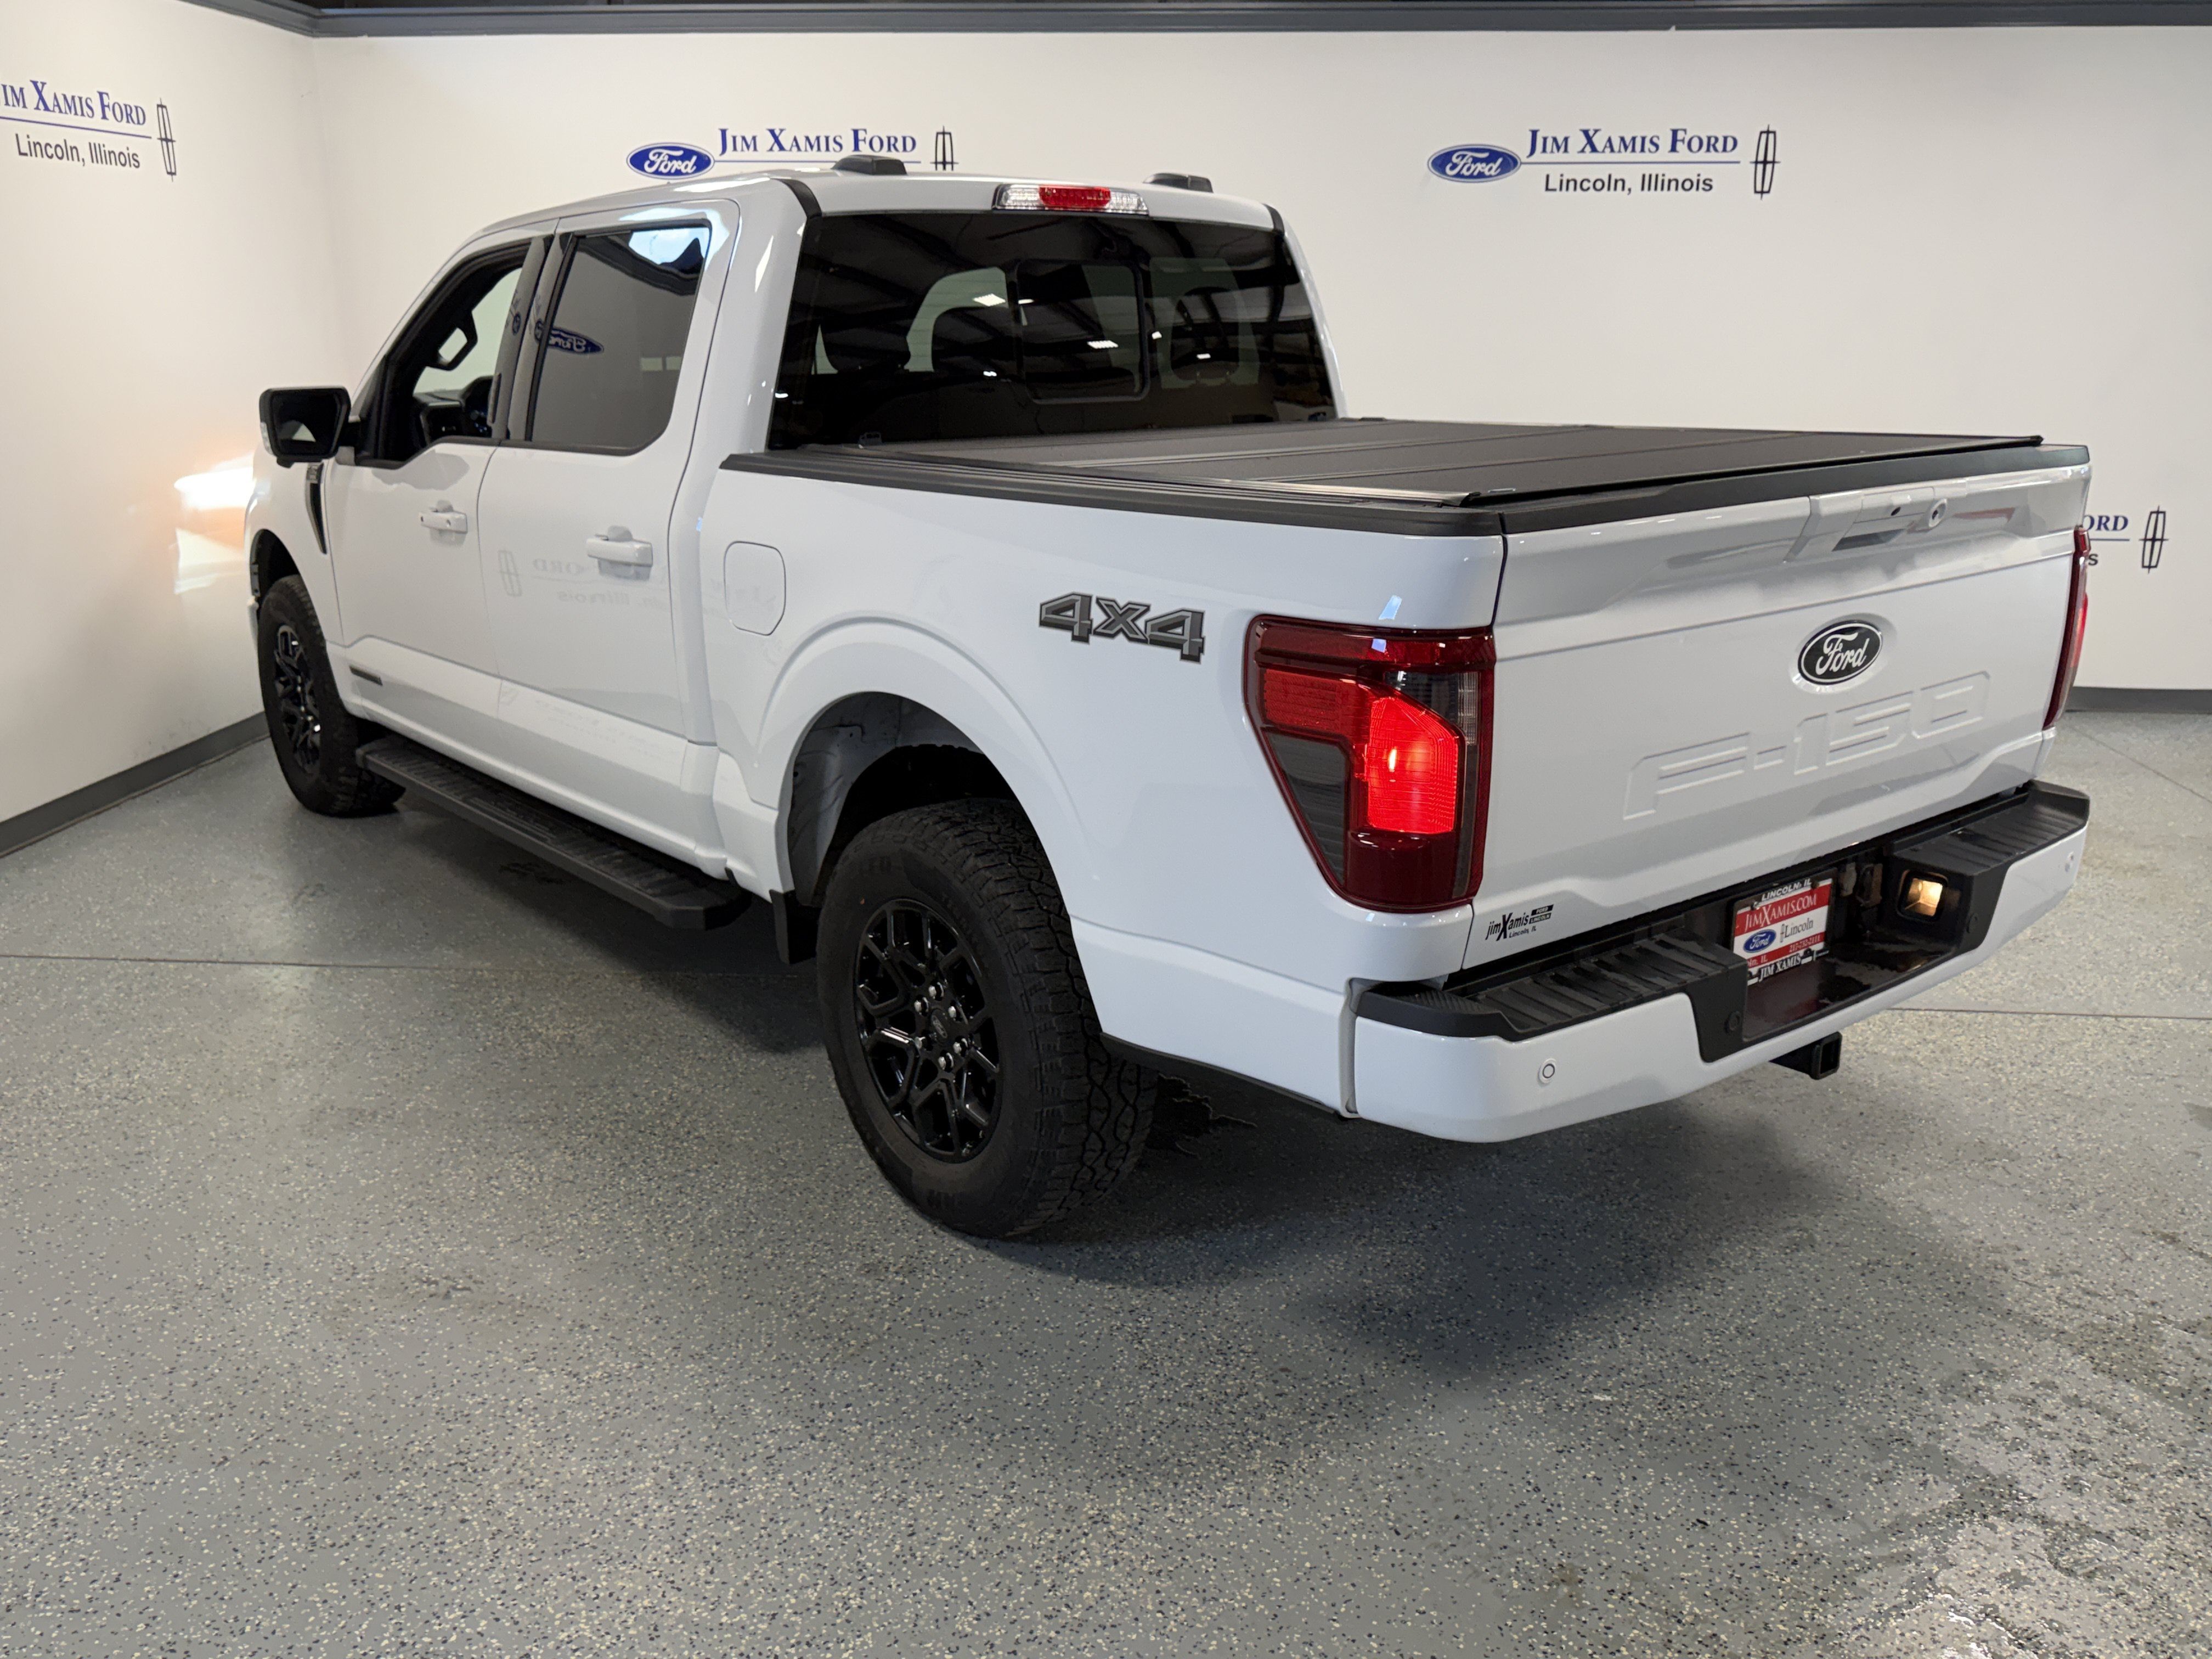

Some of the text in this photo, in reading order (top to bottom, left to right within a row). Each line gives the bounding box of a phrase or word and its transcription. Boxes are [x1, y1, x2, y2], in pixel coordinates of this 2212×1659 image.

[0, 80, 146, 126] IM XAMIS FORD
[15, 133, 140, 168] Lincoln, Illinois
[718, 128, 917, 156] JIM XAMIS FORD
[1526, 128, 1738, 158] JIM XAMIS FORD
[644, 149, 697, 173] Ford
[1445, 151, 1503, 176] Ford
[1544, 173, 1713, 195] Lincoln, Illinois
[2084, 515, 2129, 531] ORD
[1815, 632, 1870, 675] Ford
[1624, 670, 1990, 820] F-150
[1804, 878, 1812, 887] IL
[1785, 918, 1813, 938] Lincoln
[1759, 966, 1774, 981] JIM
[1776, 954, 1801, 973] XAMIS
